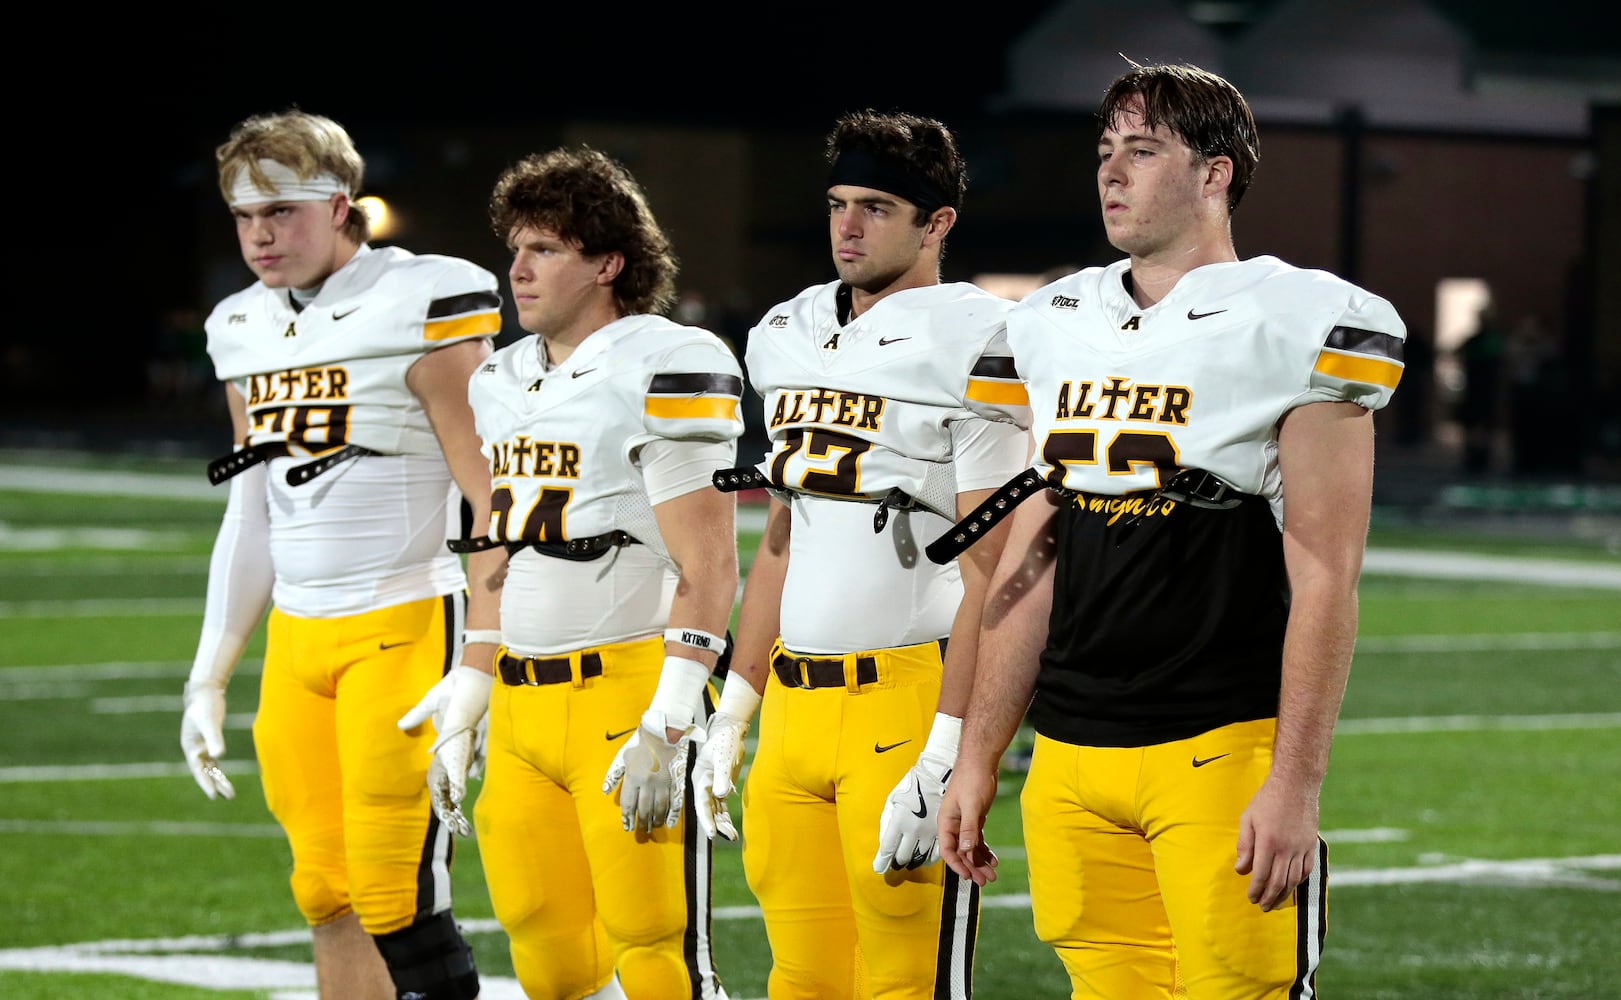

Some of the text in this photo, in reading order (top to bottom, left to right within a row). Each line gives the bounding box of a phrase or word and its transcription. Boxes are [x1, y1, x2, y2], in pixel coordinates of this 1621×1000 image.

[823, 333, 841, 350] A
[1120, 315, 1143, 331] A
[247, 366, 349, 407] ALTER
[1055, 376, 1193, 427] ALTER
[769, 388, 886, 433] ALTER
[492, 435, 581, 480] ALTER
